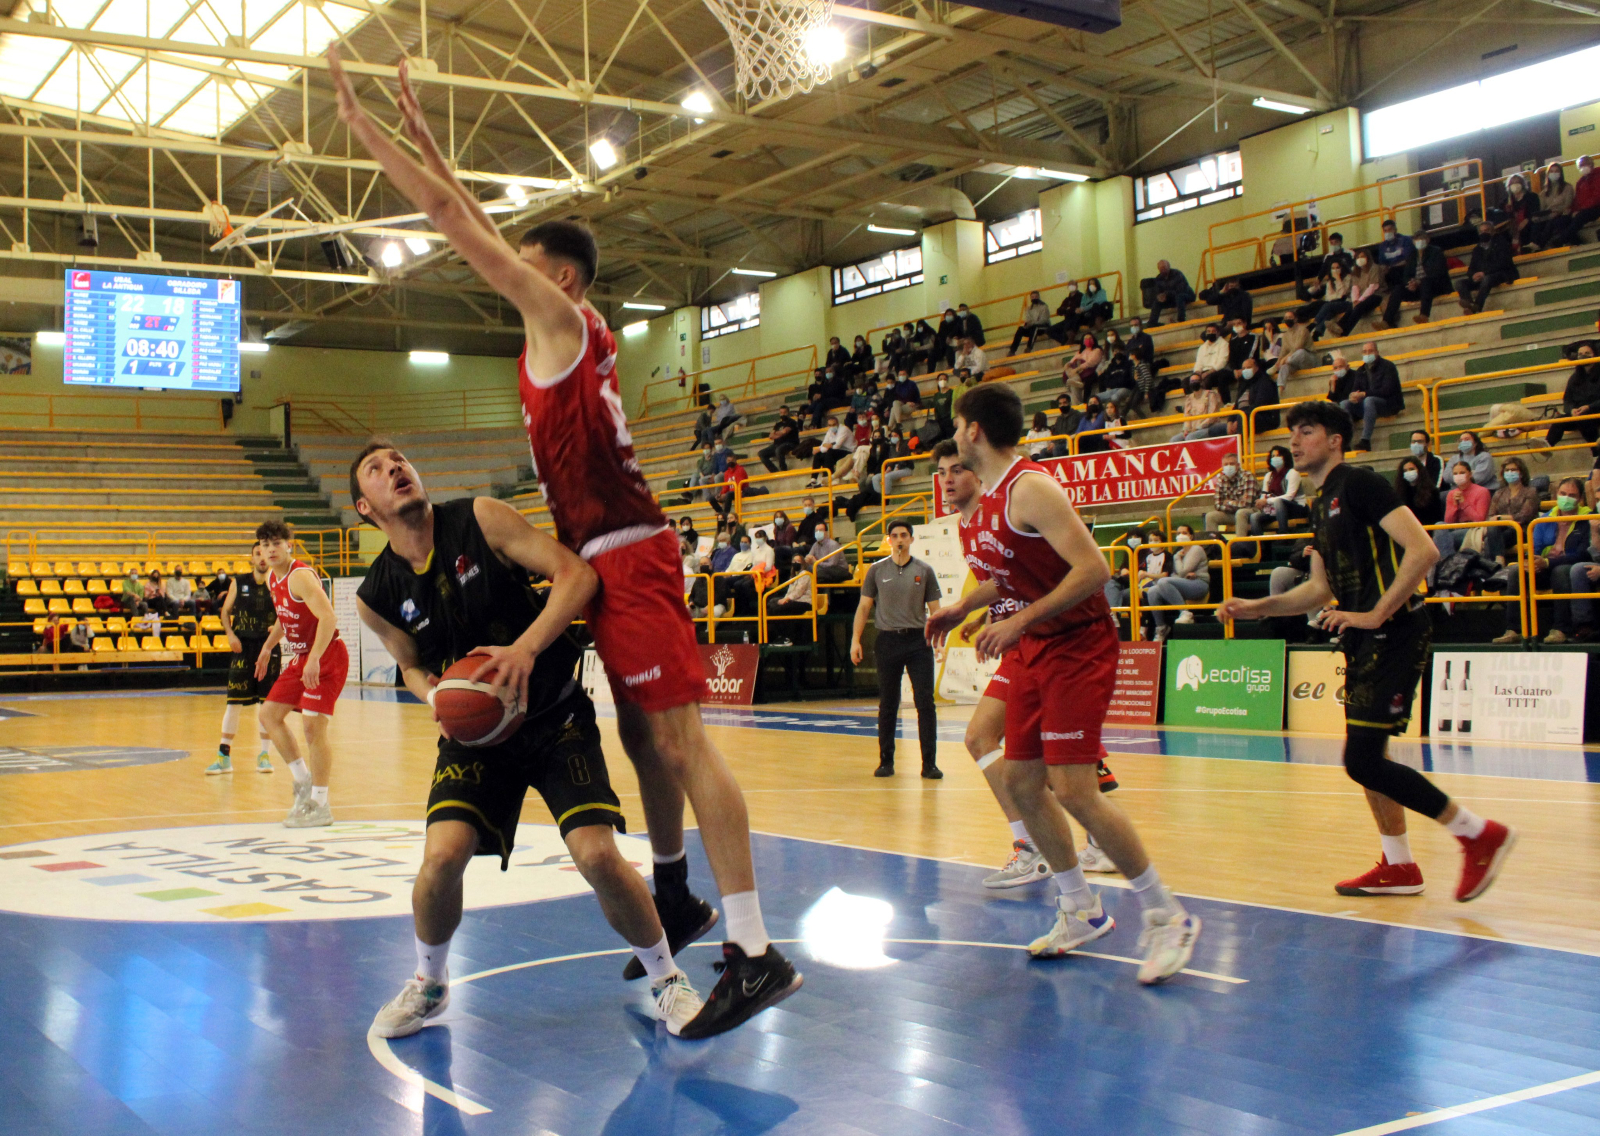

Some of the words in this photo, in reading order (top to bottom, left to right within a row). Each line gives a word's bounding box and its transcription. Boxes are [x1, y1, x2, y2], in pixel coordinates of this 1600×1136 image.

[113, 283, 143, 291] ANTIGUA
[121, 294, 145, 312] 22
[162, 297, 185, 315] 18
[127, 338, 179, 358] 08:40
[130, 360, 138, 375] 1
[168, 361, 176, 376] 1
[1065, 486, 1087, 503] DE
[1092, 483, 1113, 502] LA
[623, 665, 661, 688] ONBUS
[1210, 666, 1271, 684] ecotisa
[1246, 684, 1270, 693] grupo
[1292, 682, 1326, 700] El
[1494, 685, 1512, 696] Las
[1514, 685, 1552, 697] Cuatro
[1195, 706, 1248, 716] #GrupoEcotisa
[1506, 698, 1539, 708] TTTT
[568, 754, 590, 785] 8
[84, 841, 392, 904] CASTILLA
